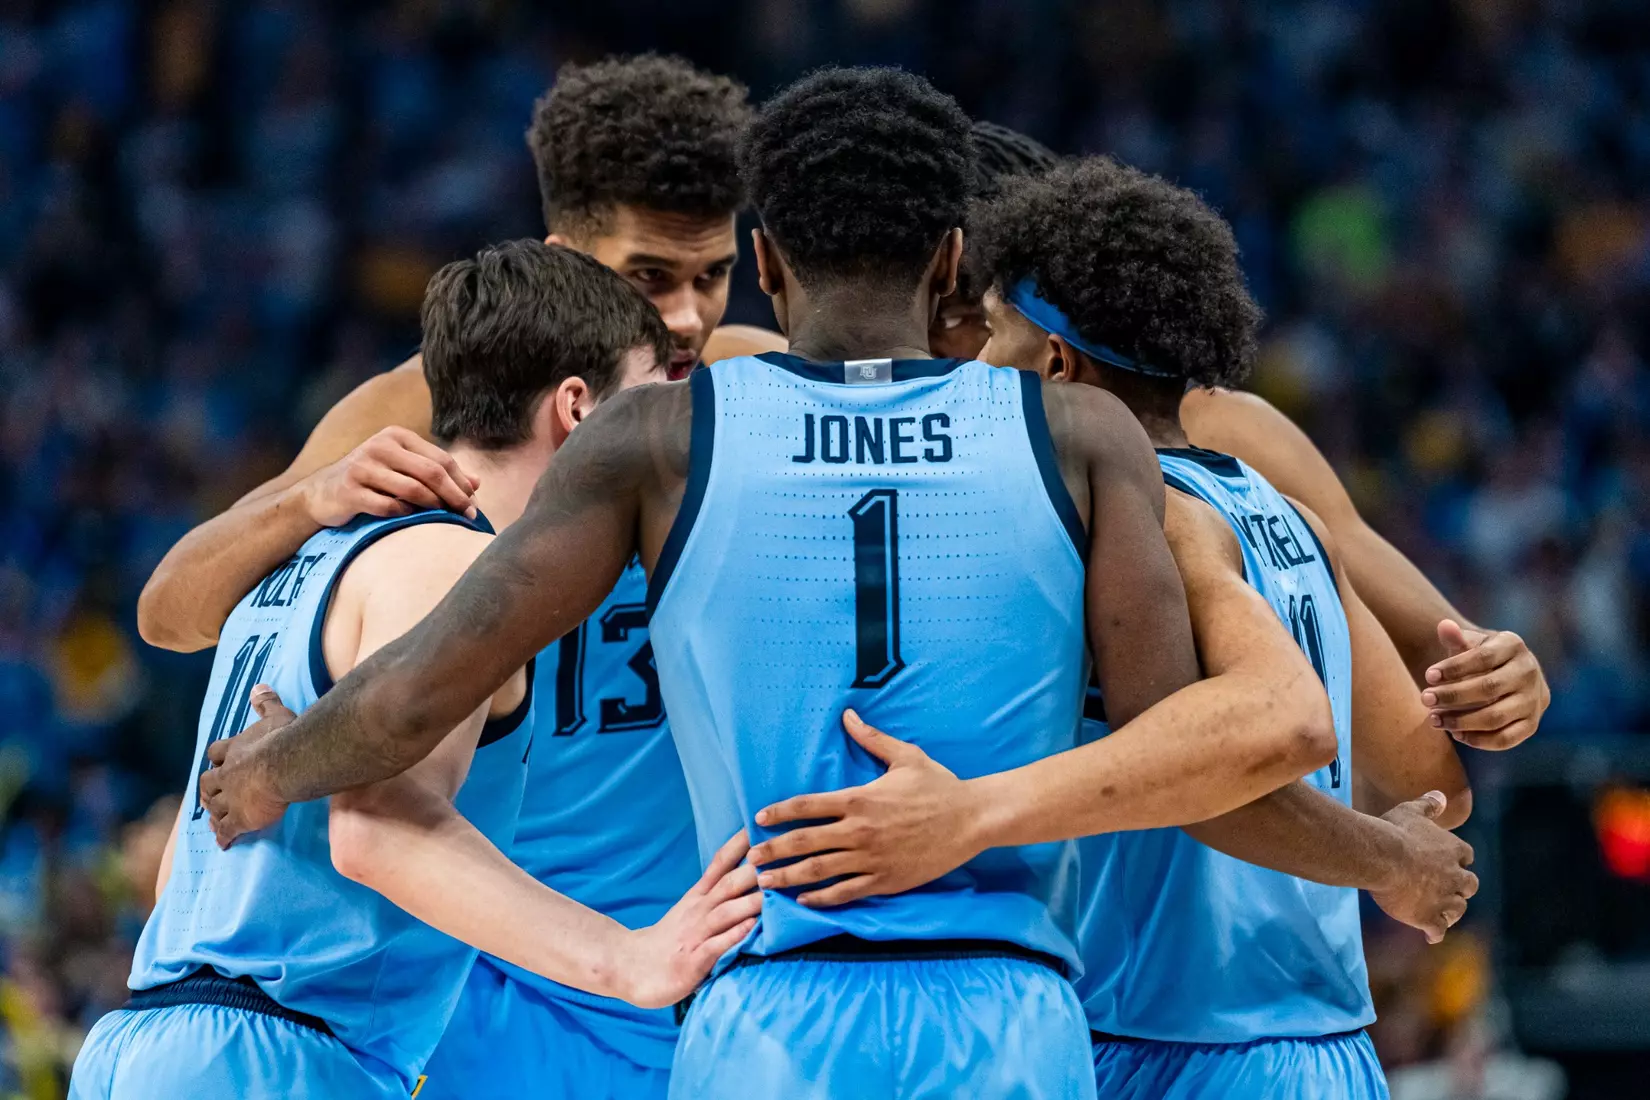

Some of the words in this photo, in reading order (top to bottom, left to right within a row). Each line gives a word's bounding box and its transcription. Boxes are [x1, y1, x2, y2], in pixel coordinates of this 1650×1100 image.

[792, 413, 952, 464] JONES
[847, 488, 906, 688] 1
[192, 632, 279, 821] 11
[552, 603, 667, 737] 13
